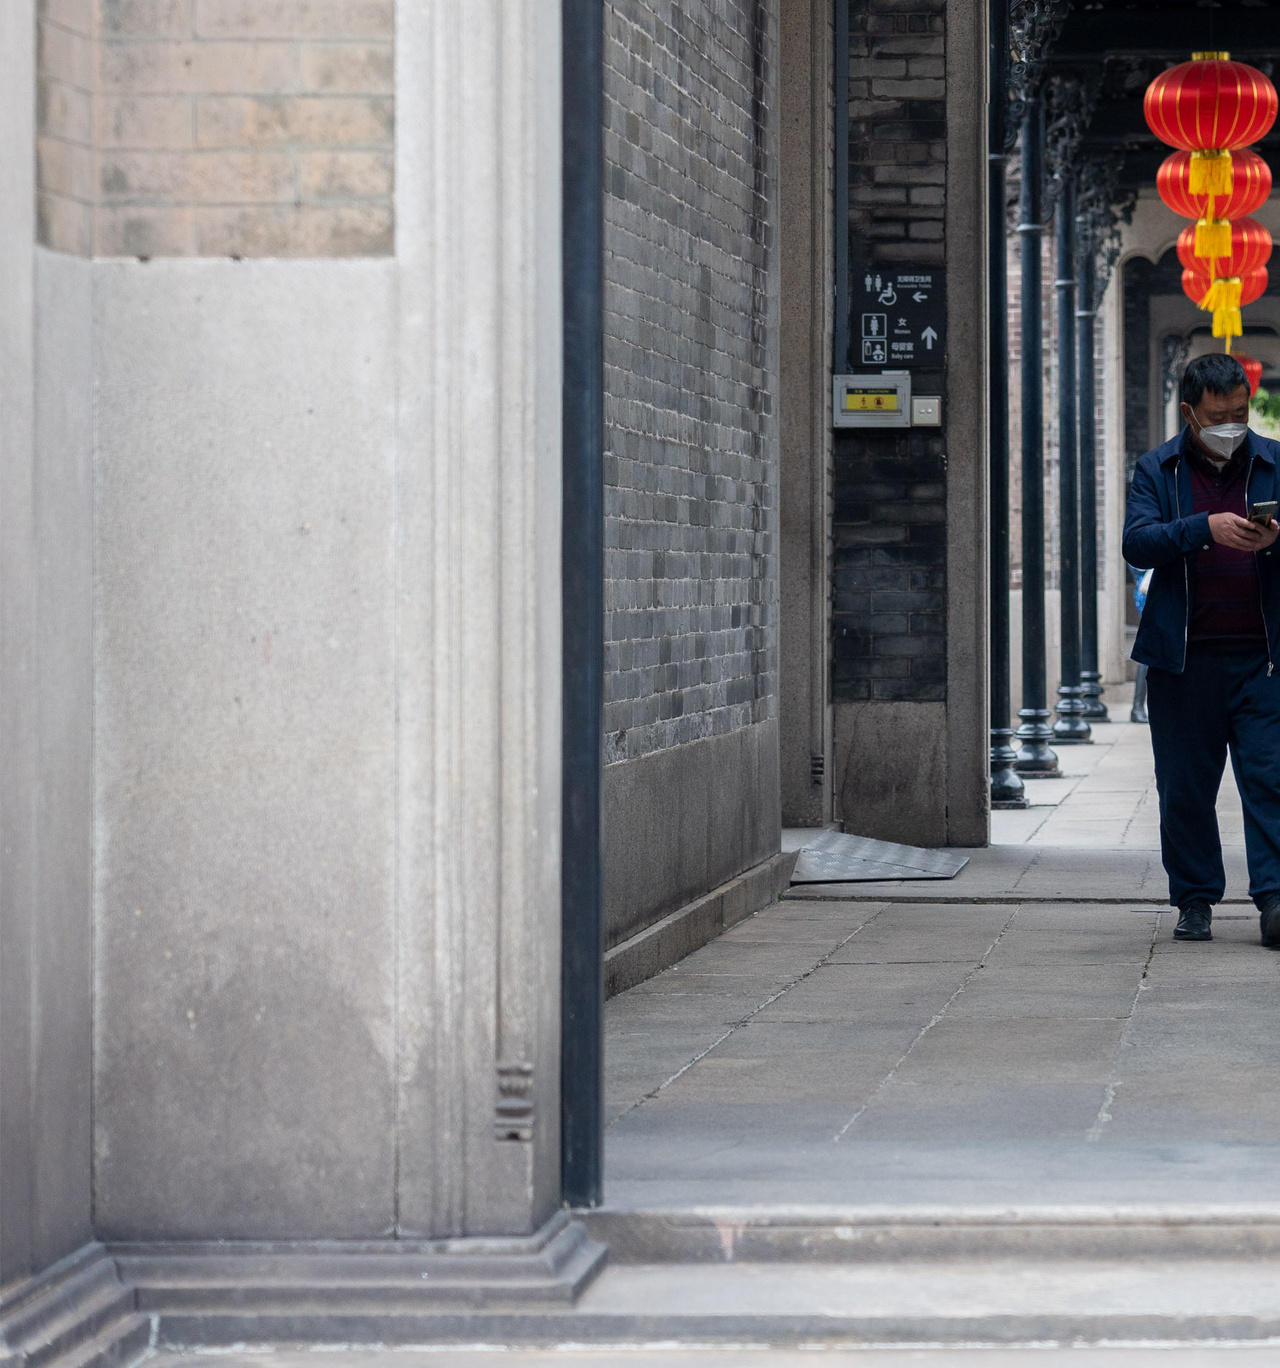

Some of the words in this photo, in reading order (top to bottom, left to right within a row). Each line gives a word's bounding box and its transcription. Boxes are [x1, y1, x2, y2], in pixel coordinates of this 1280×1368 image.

[897, 317, 907, 326] 女
[891, 342, 914, 351] 母婴室
